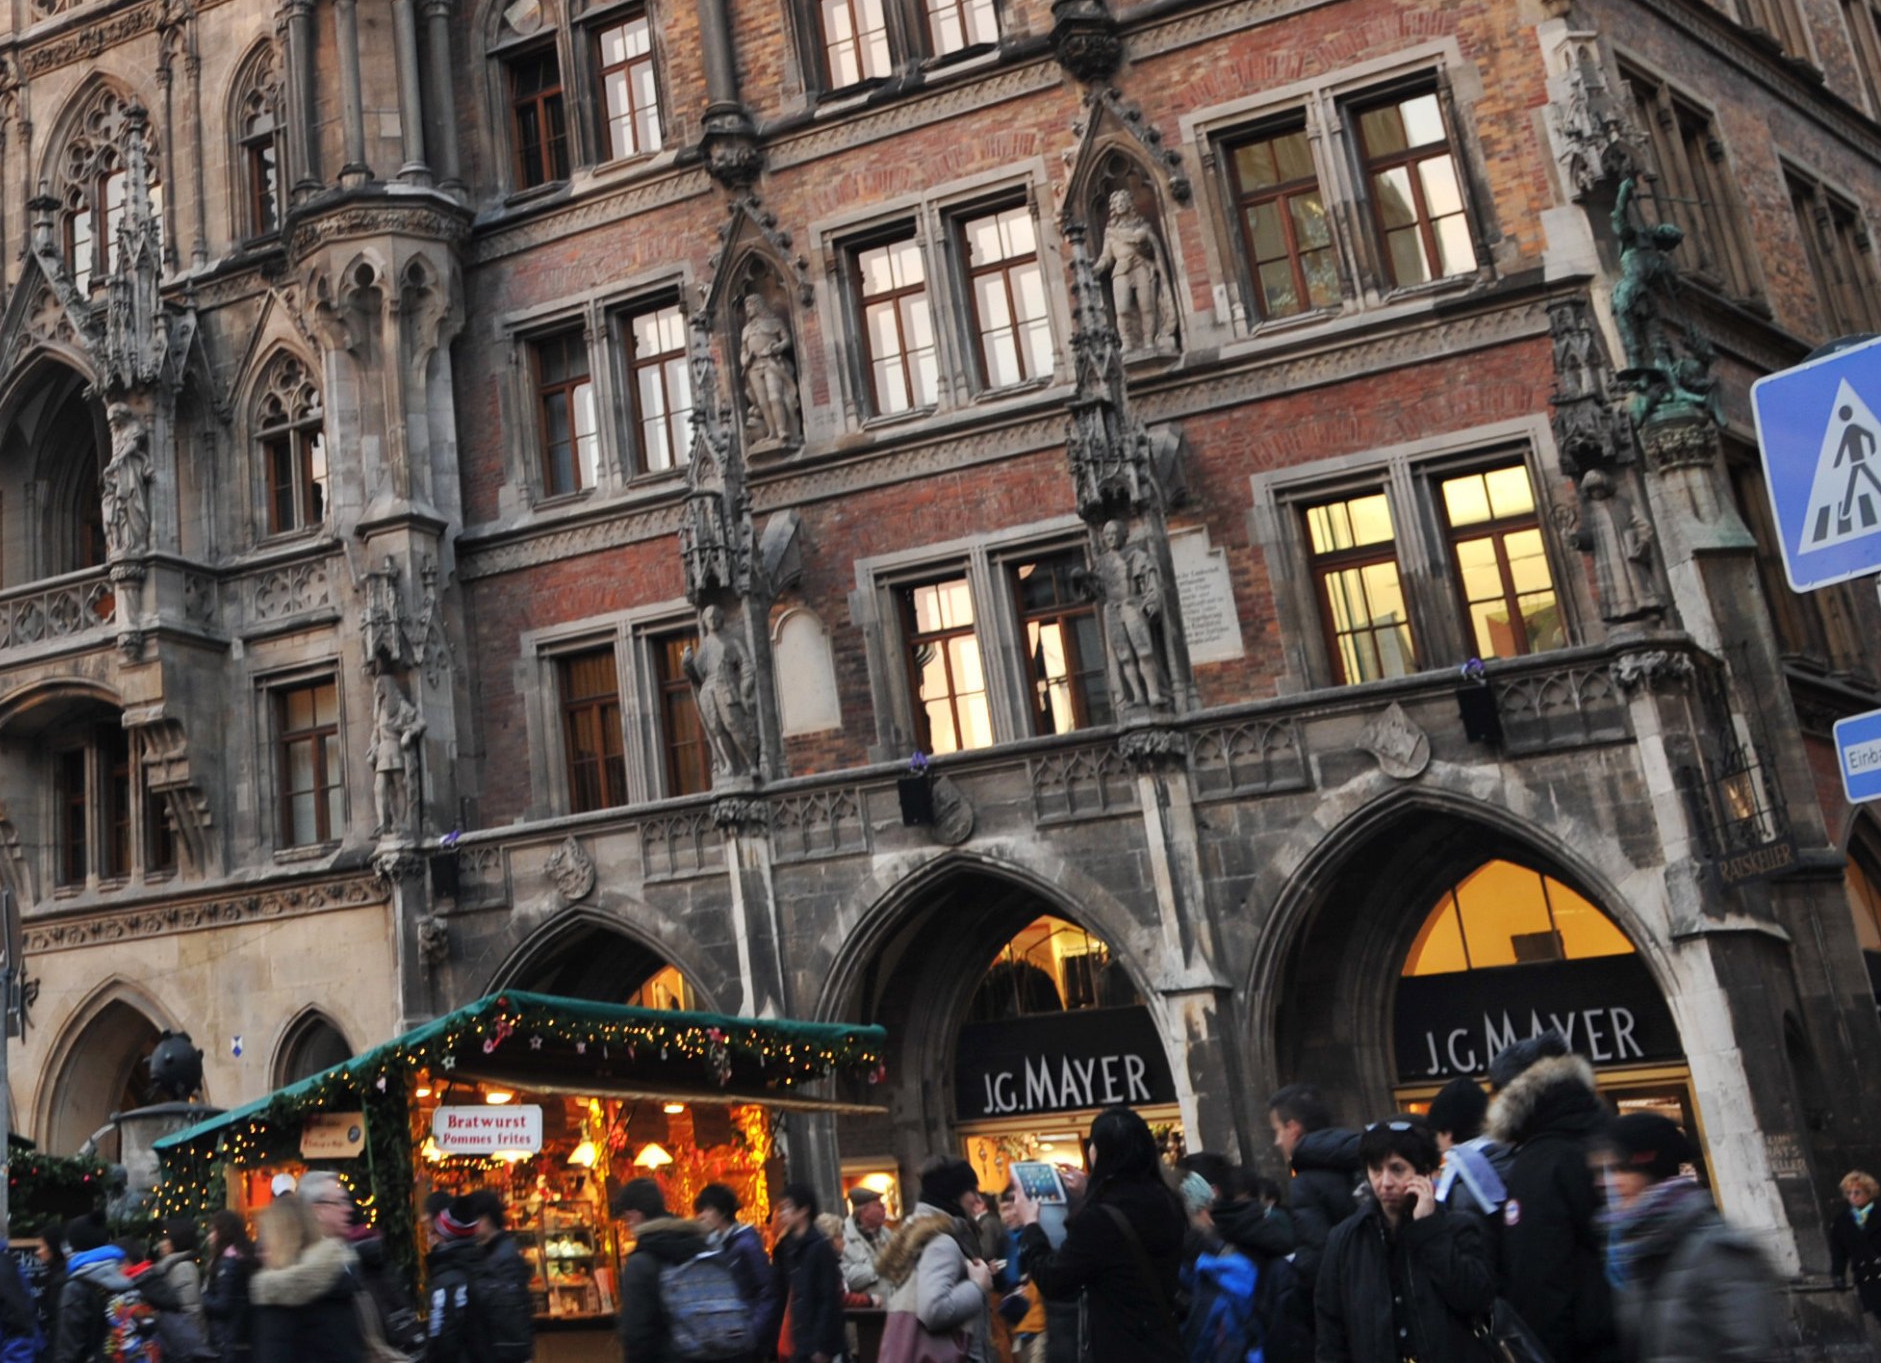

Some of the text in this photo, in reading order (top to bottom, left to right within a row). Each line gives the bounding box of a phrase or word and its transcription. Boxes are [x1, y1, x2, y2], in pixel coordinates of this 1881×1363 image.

[1848, 746, 1881, 769] Einb
[448, 1114, 527, 1128] Bratwurst
[443, 1133, 531, 1145] Pommes frites
